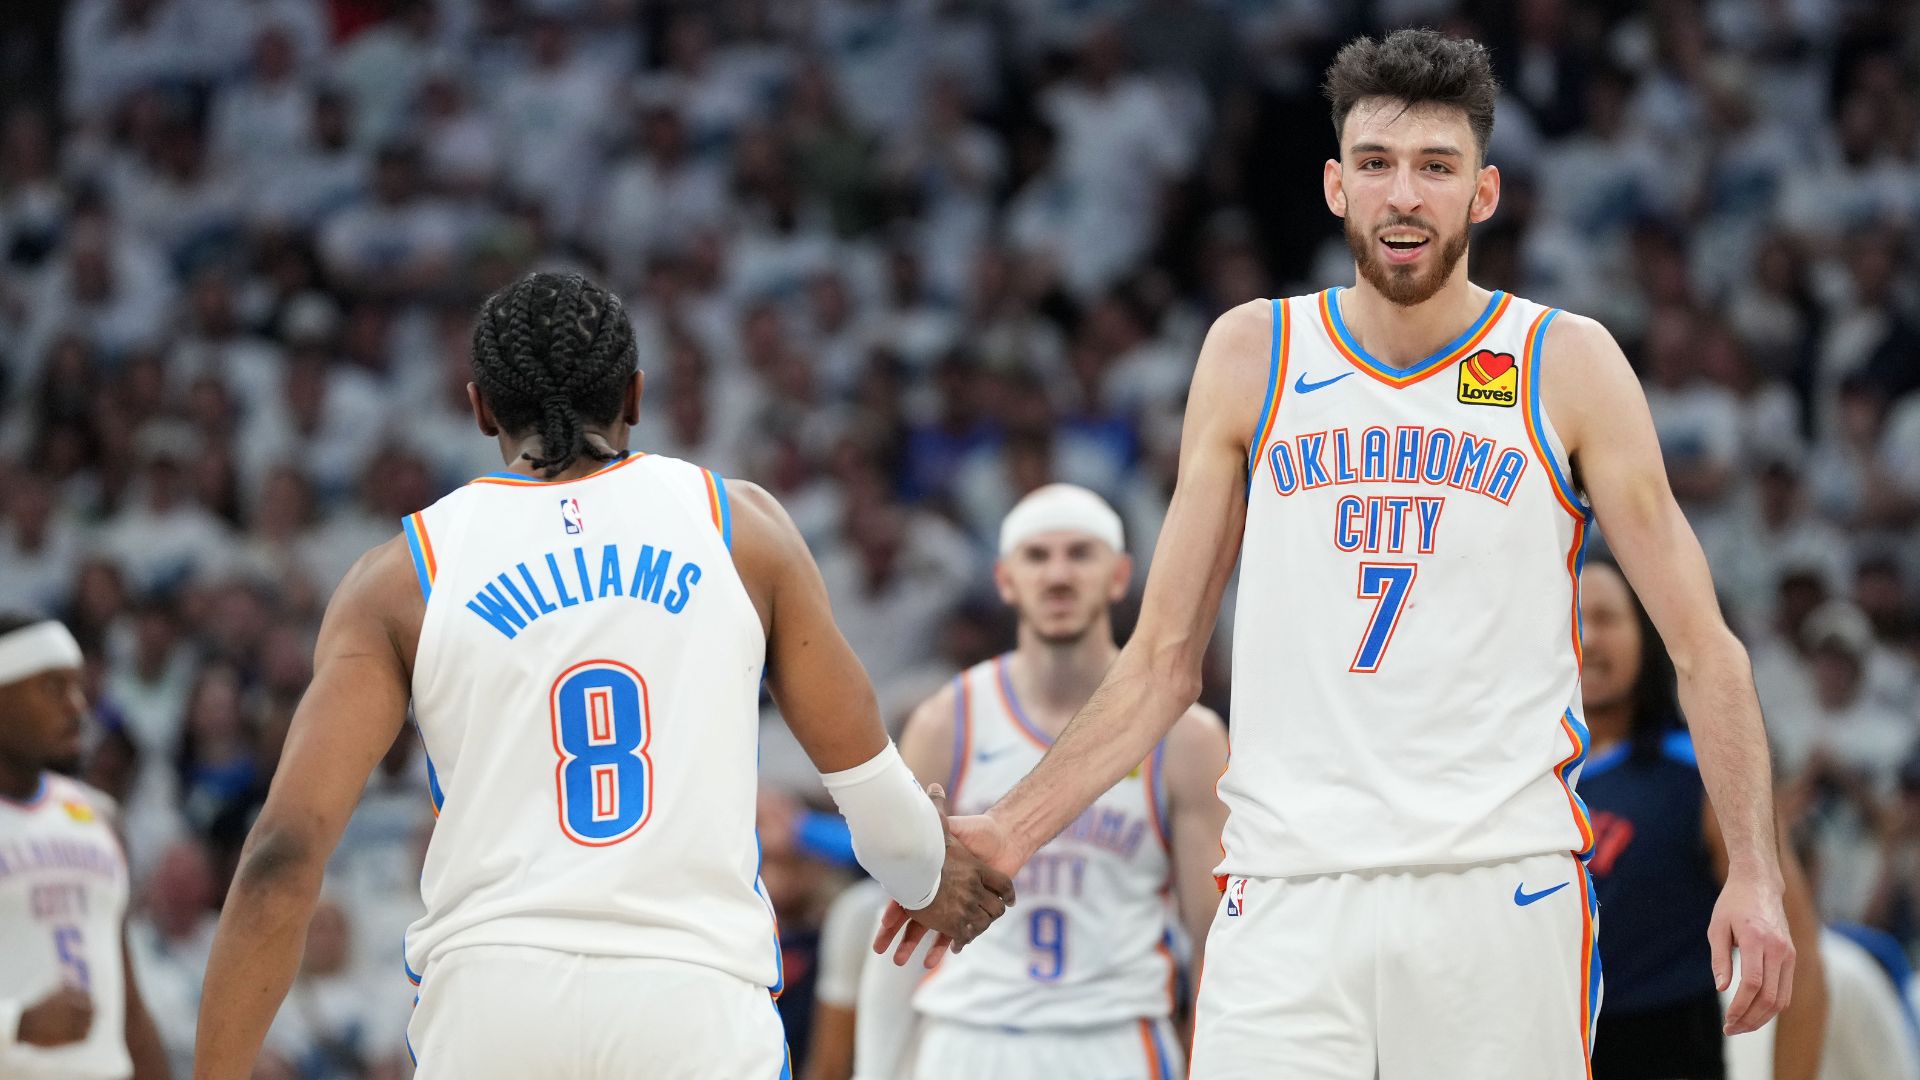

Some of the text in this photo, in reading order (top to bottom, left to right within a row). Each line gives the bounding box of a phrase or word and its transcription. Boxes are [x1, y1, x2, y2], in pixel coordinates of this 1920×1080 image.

[1268, 426, 1528, 506] OKLAHOMA
[1334, 495, 1446, 554] CITY
[466, 544, 702, 640] WILLIAMS
[1349, 562, 1418, 673] 7
[550, 659, 653, 848] 8
[1027, 905, 1066, 985] 9
